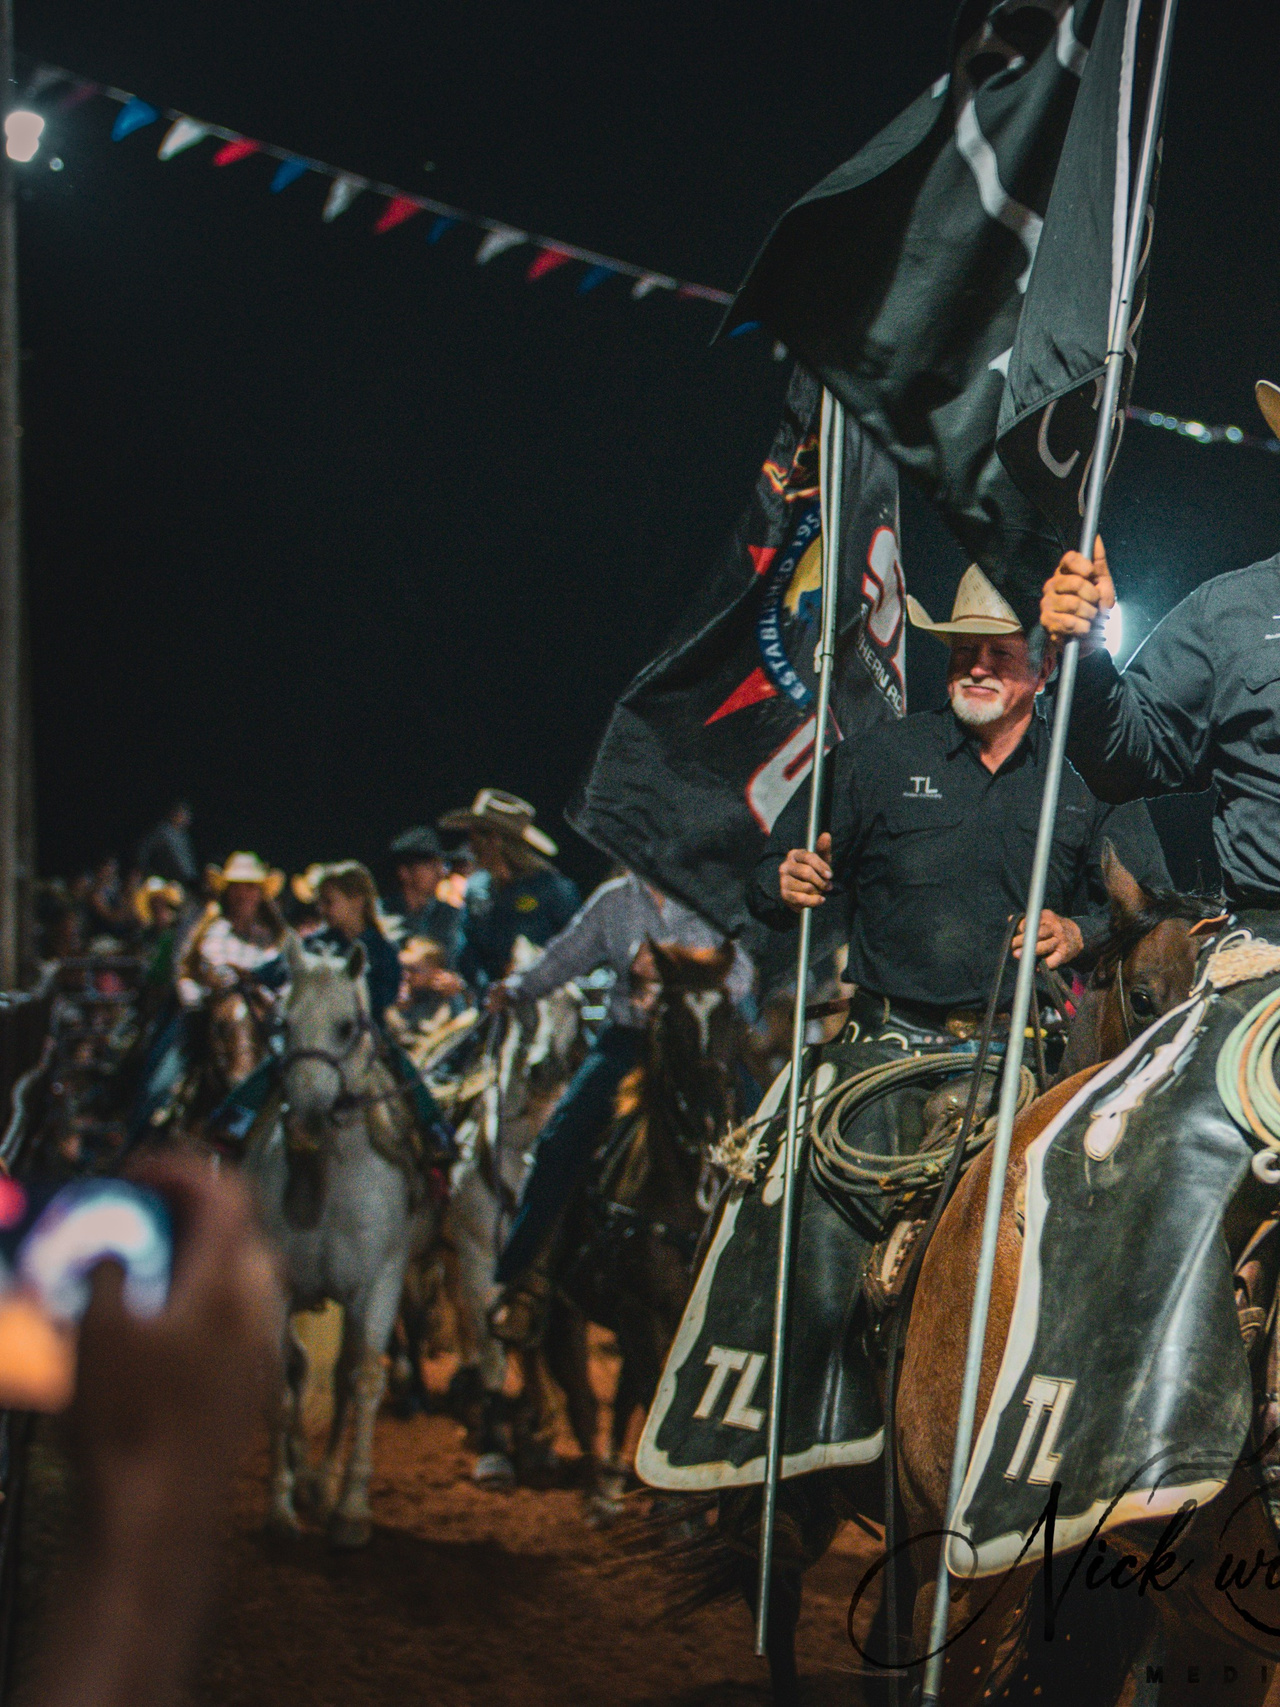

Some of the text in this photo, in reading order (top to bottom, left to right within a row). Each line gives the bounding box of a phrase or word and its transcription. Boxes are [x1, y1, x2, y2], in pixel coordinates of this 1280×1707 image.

[792, 508, 822, 548] 195
[910, 776, 938, 794] TL
[693, 1345, 768, 1431] TL
[1003, 1374, 1077, 1486] TL
